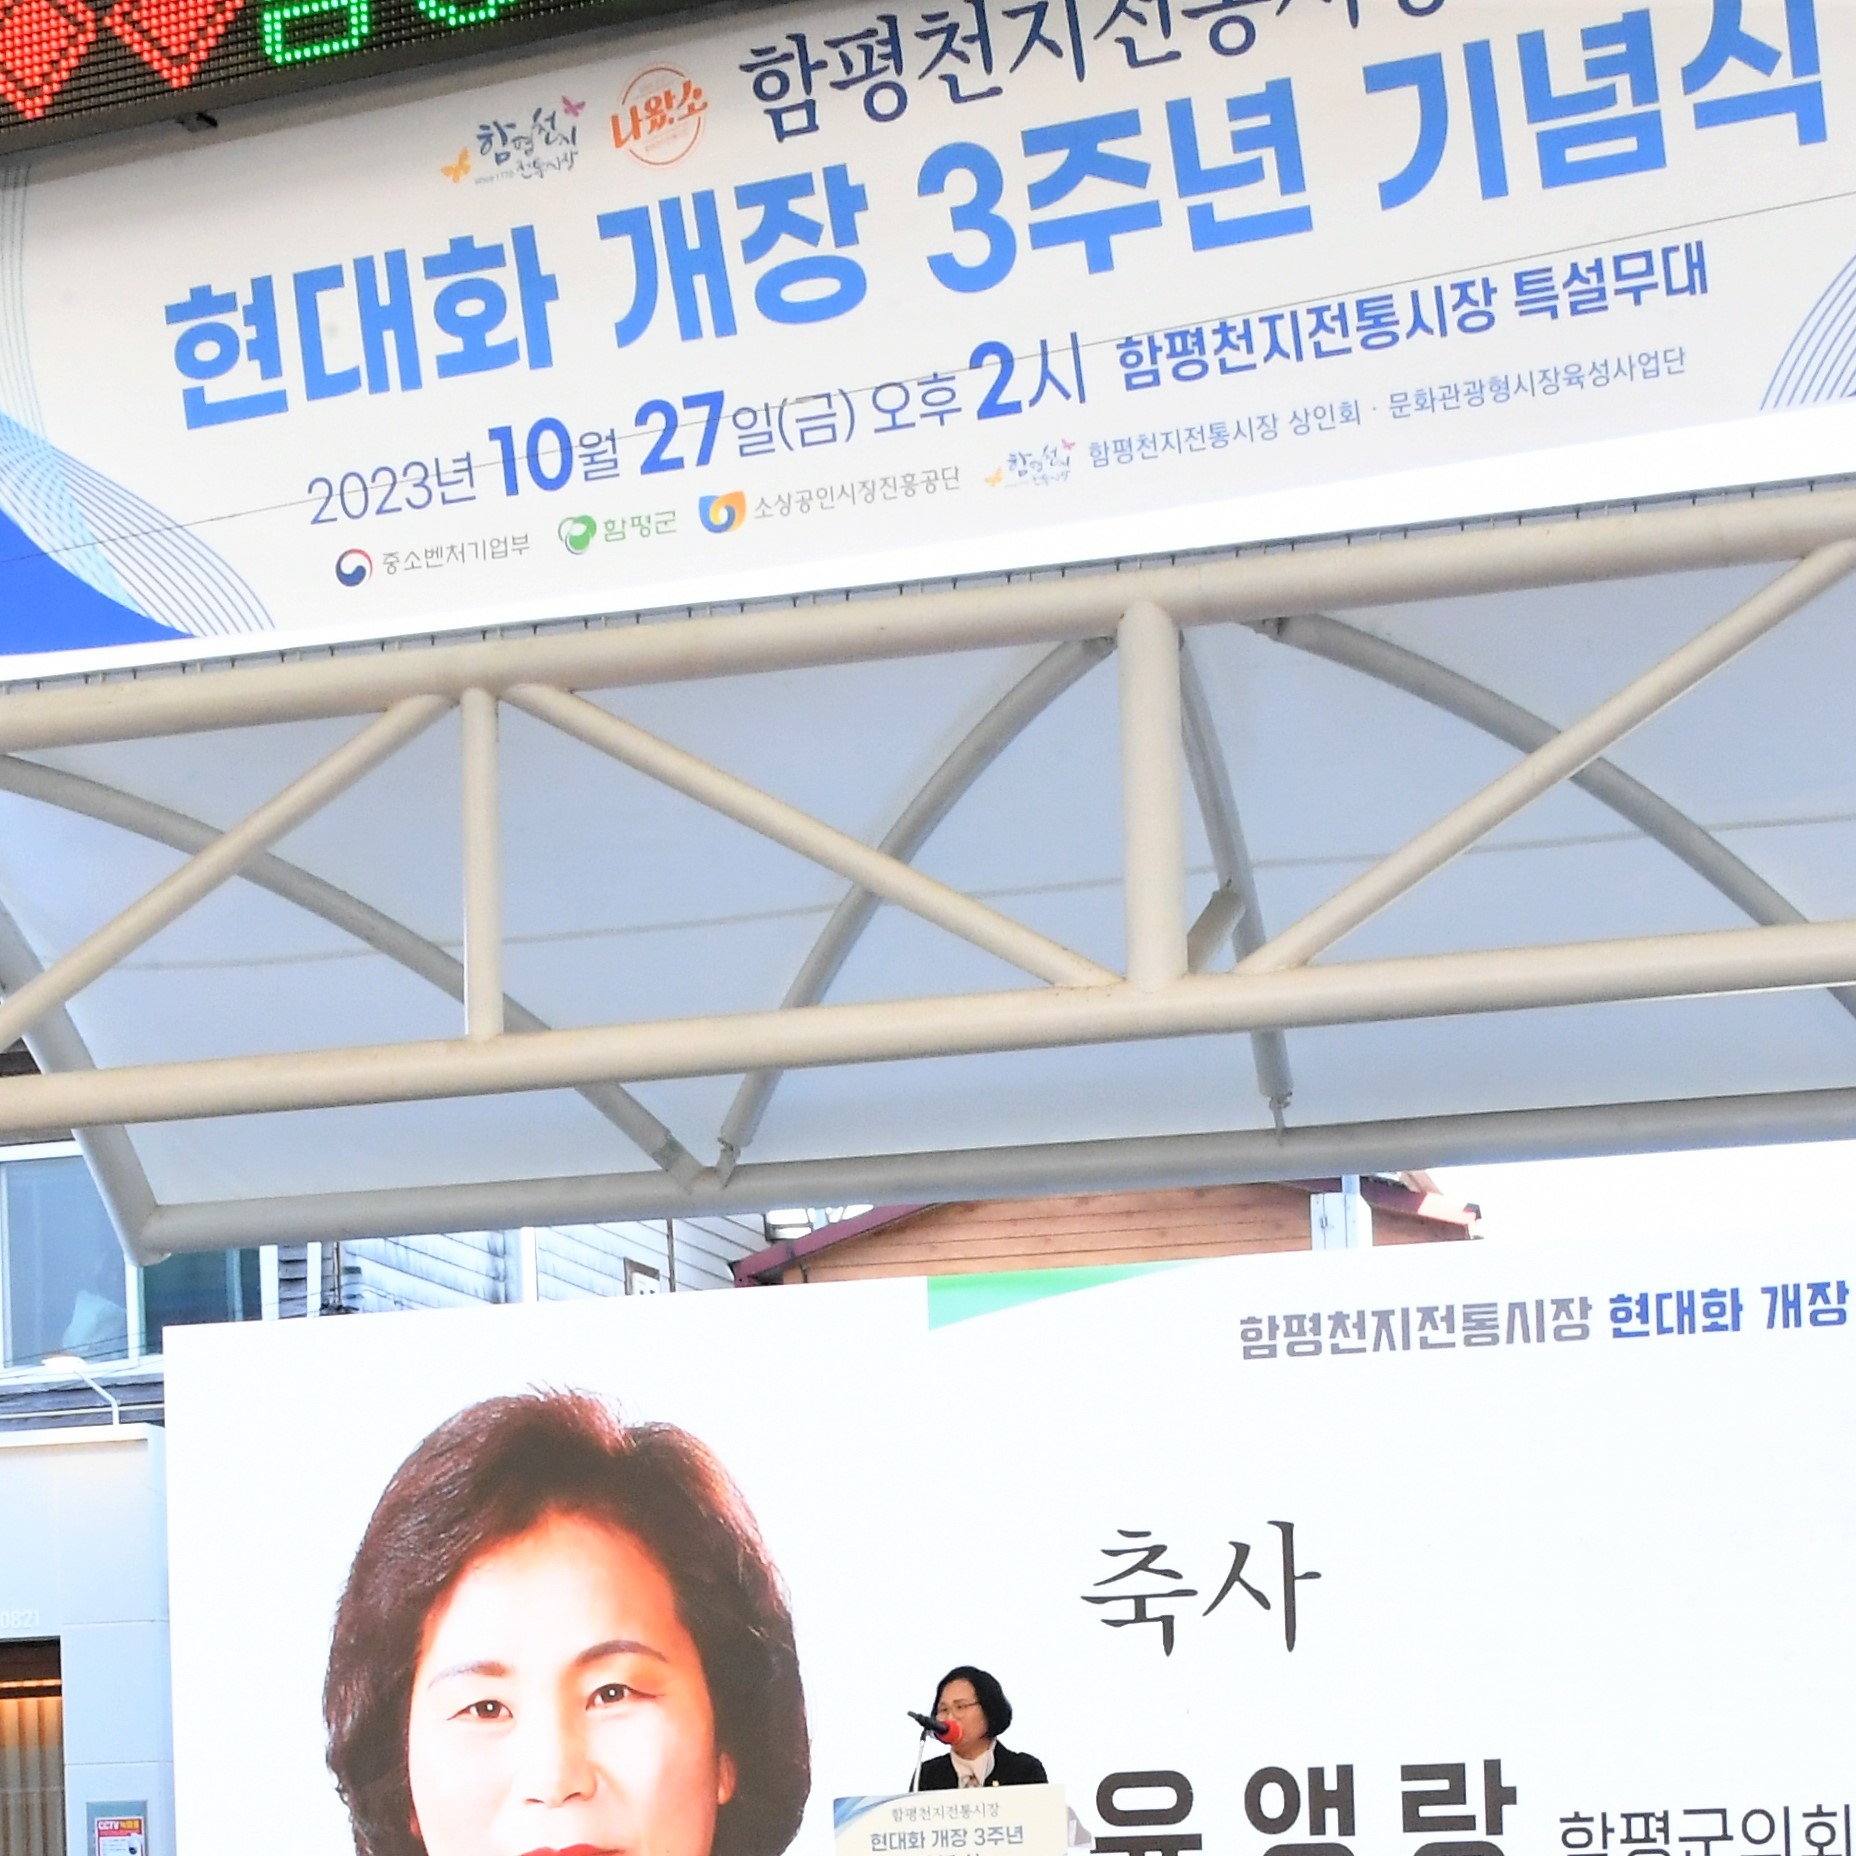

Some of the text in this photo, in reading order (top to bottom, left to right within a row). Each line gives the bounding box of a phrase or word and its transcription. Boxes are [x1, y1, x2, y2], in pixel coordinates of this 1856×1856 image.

[164, 0, 1830, 430] 현대화 개장 3주년 기념식
[306, 239, 1712, 527] 2023년 10월 27일(금) 오후 2시 함평천지전통시장 특설무대
[1087, 346, 1689, 469] 함평천지전통시장 상인회 문화관광형시장육성사업단
[602, 509, 679, 544] 함평군
[751, 466, 963, 521] 소상공인시장진흥공단
[381, 532, 533, 578] 중소벤처기업부
[1237, 1294, 1594, 1362] 함평천지전통시장
[1606, 1286, 1745, 1340] 현대화
[1758, 1282, 1851, 1331] 개장
[1079, 1518, 1324, 1659] 축사
[869, 1824, 1025, 1853] 현대화 개장 3주년
[891, 1801, 1001, 1824] 함평천지전통시장
